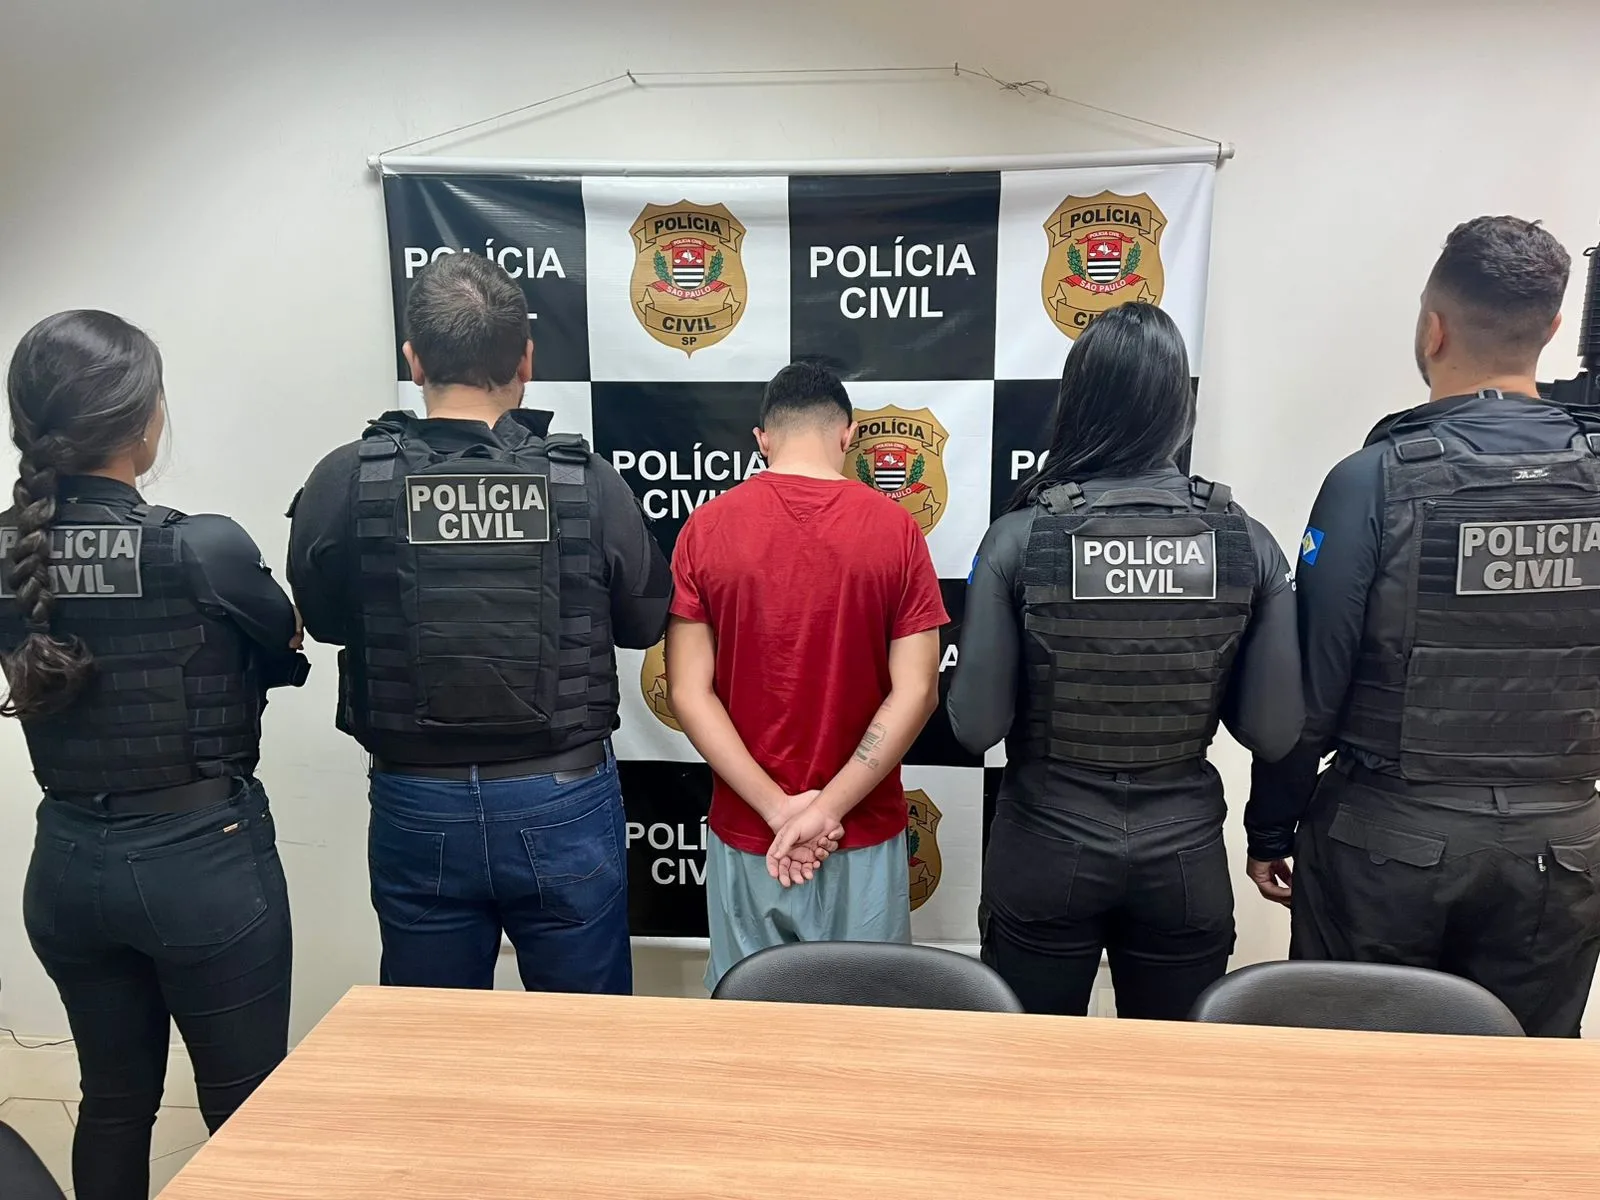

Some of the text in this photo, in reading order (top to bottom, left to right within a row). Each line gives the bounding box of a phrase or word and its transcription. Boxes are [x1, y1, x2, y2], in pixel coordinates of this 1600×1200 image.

[654, 213, 722, 235] POLÍCIA
[1070, 205, 1142, 228] POLÍCIA
[810, 235, 977, 278] POLÍCIA
[684, 285, 711, 298] PAULO
[1099, 280, 1126, 292] PAULO
[840, 286, 944, 320] CIVIL
[662, 316, 717, 332] CIVIL
[681, 336, 697, 346] SP
[858, 418, 925, 439] POLÍCIA
[612, 442, 768, 481] POLÍCIA
[411, 478, 546, 512] POLÍCIA
[643, 488, 728, 519] CIV
[438, 512, 525, 540] CIVIL
[1464, 522, 1600, 557] POLÍCIA
[0, 529, 136, 559] PLÍCIA
[1083, 536, 1206, 565] POLÍCIA
[47, 564, 116, 593] IVIL
[1105, 568, 1184, 594] CIVIL
[1483, 557, 1583, 590] CIVIL
[625, 815, 708, 850] POLÍ
[651, 857, 707, 885] CIV
